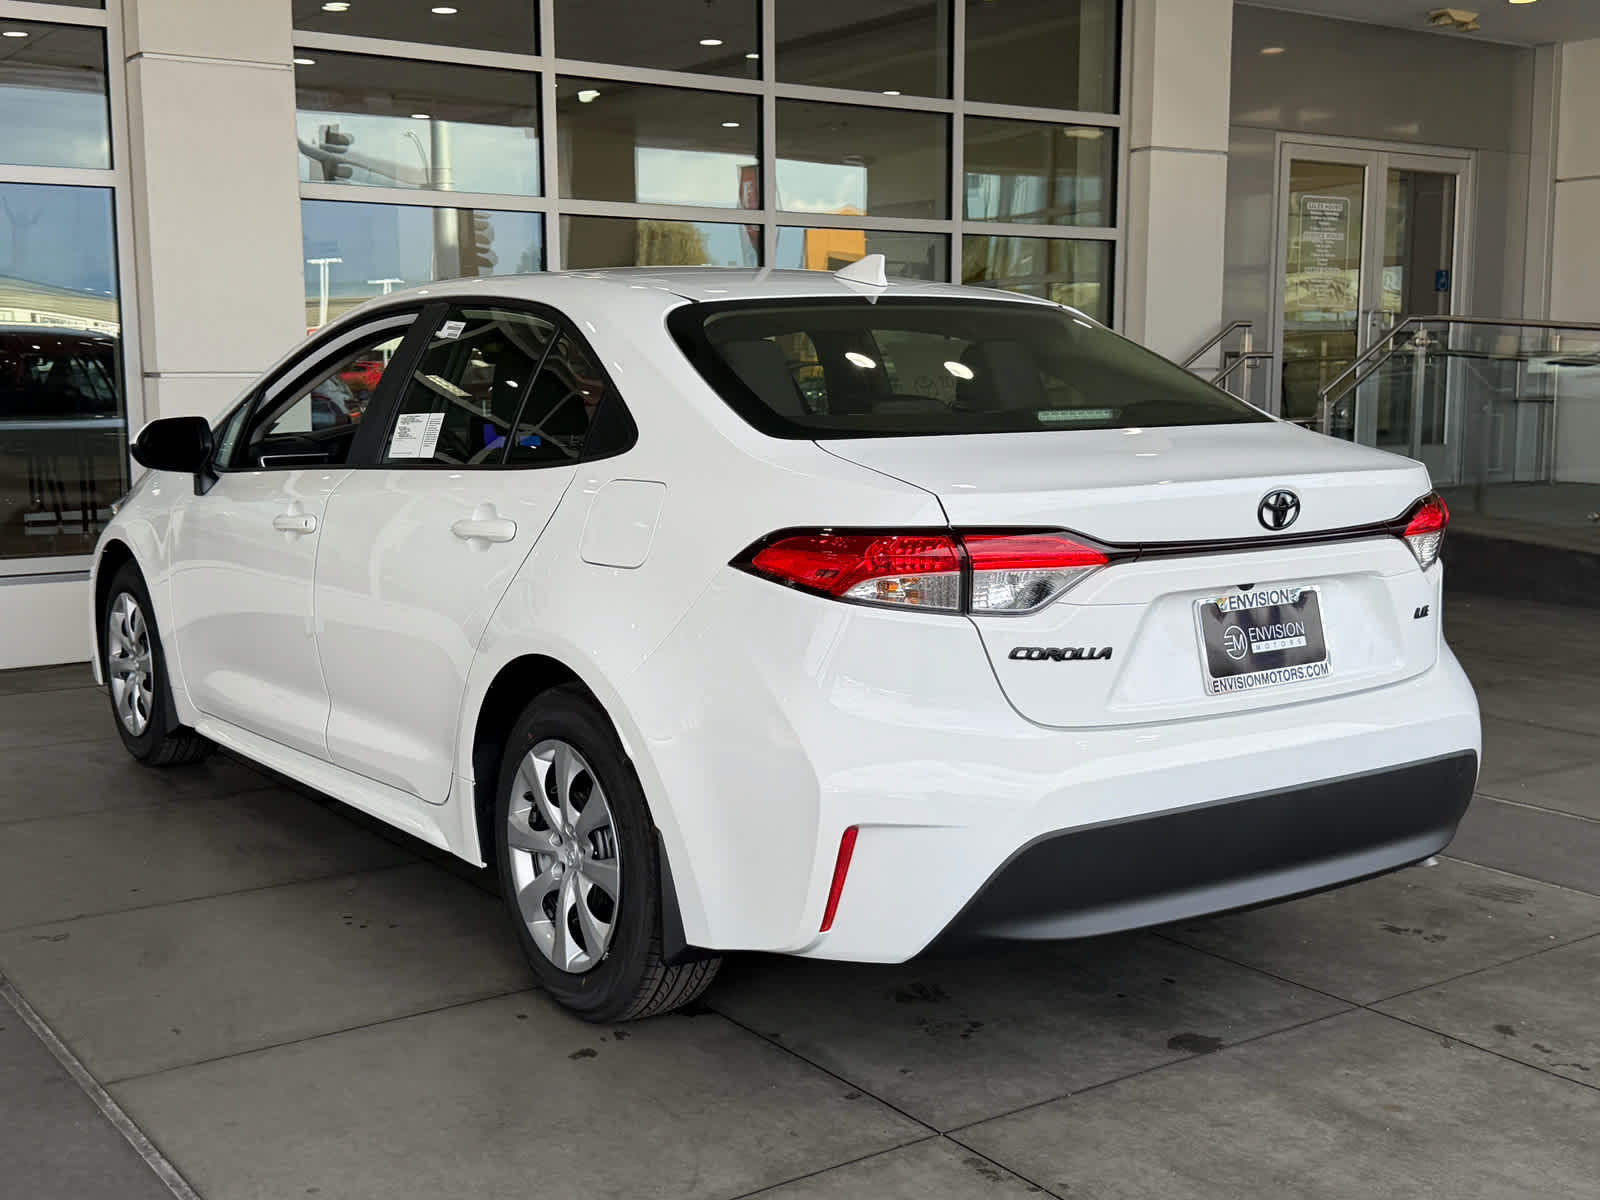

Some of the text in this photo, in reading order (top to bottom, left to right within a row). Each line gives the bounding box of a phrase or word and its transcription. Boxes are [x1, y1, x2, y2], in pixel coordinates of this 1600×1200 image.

[1229, 589, 1289, 610] ENVISION
[1414, 604, 1430, 619] LE
[1249, 622, 1305, 642] ENVISION
[1255, 639, 1303, 650] MOTORS
[1008, 646, 1113, 662] COROLLA
[1213, 663, 1329, 693] ENVISIONMOTORS.COM
